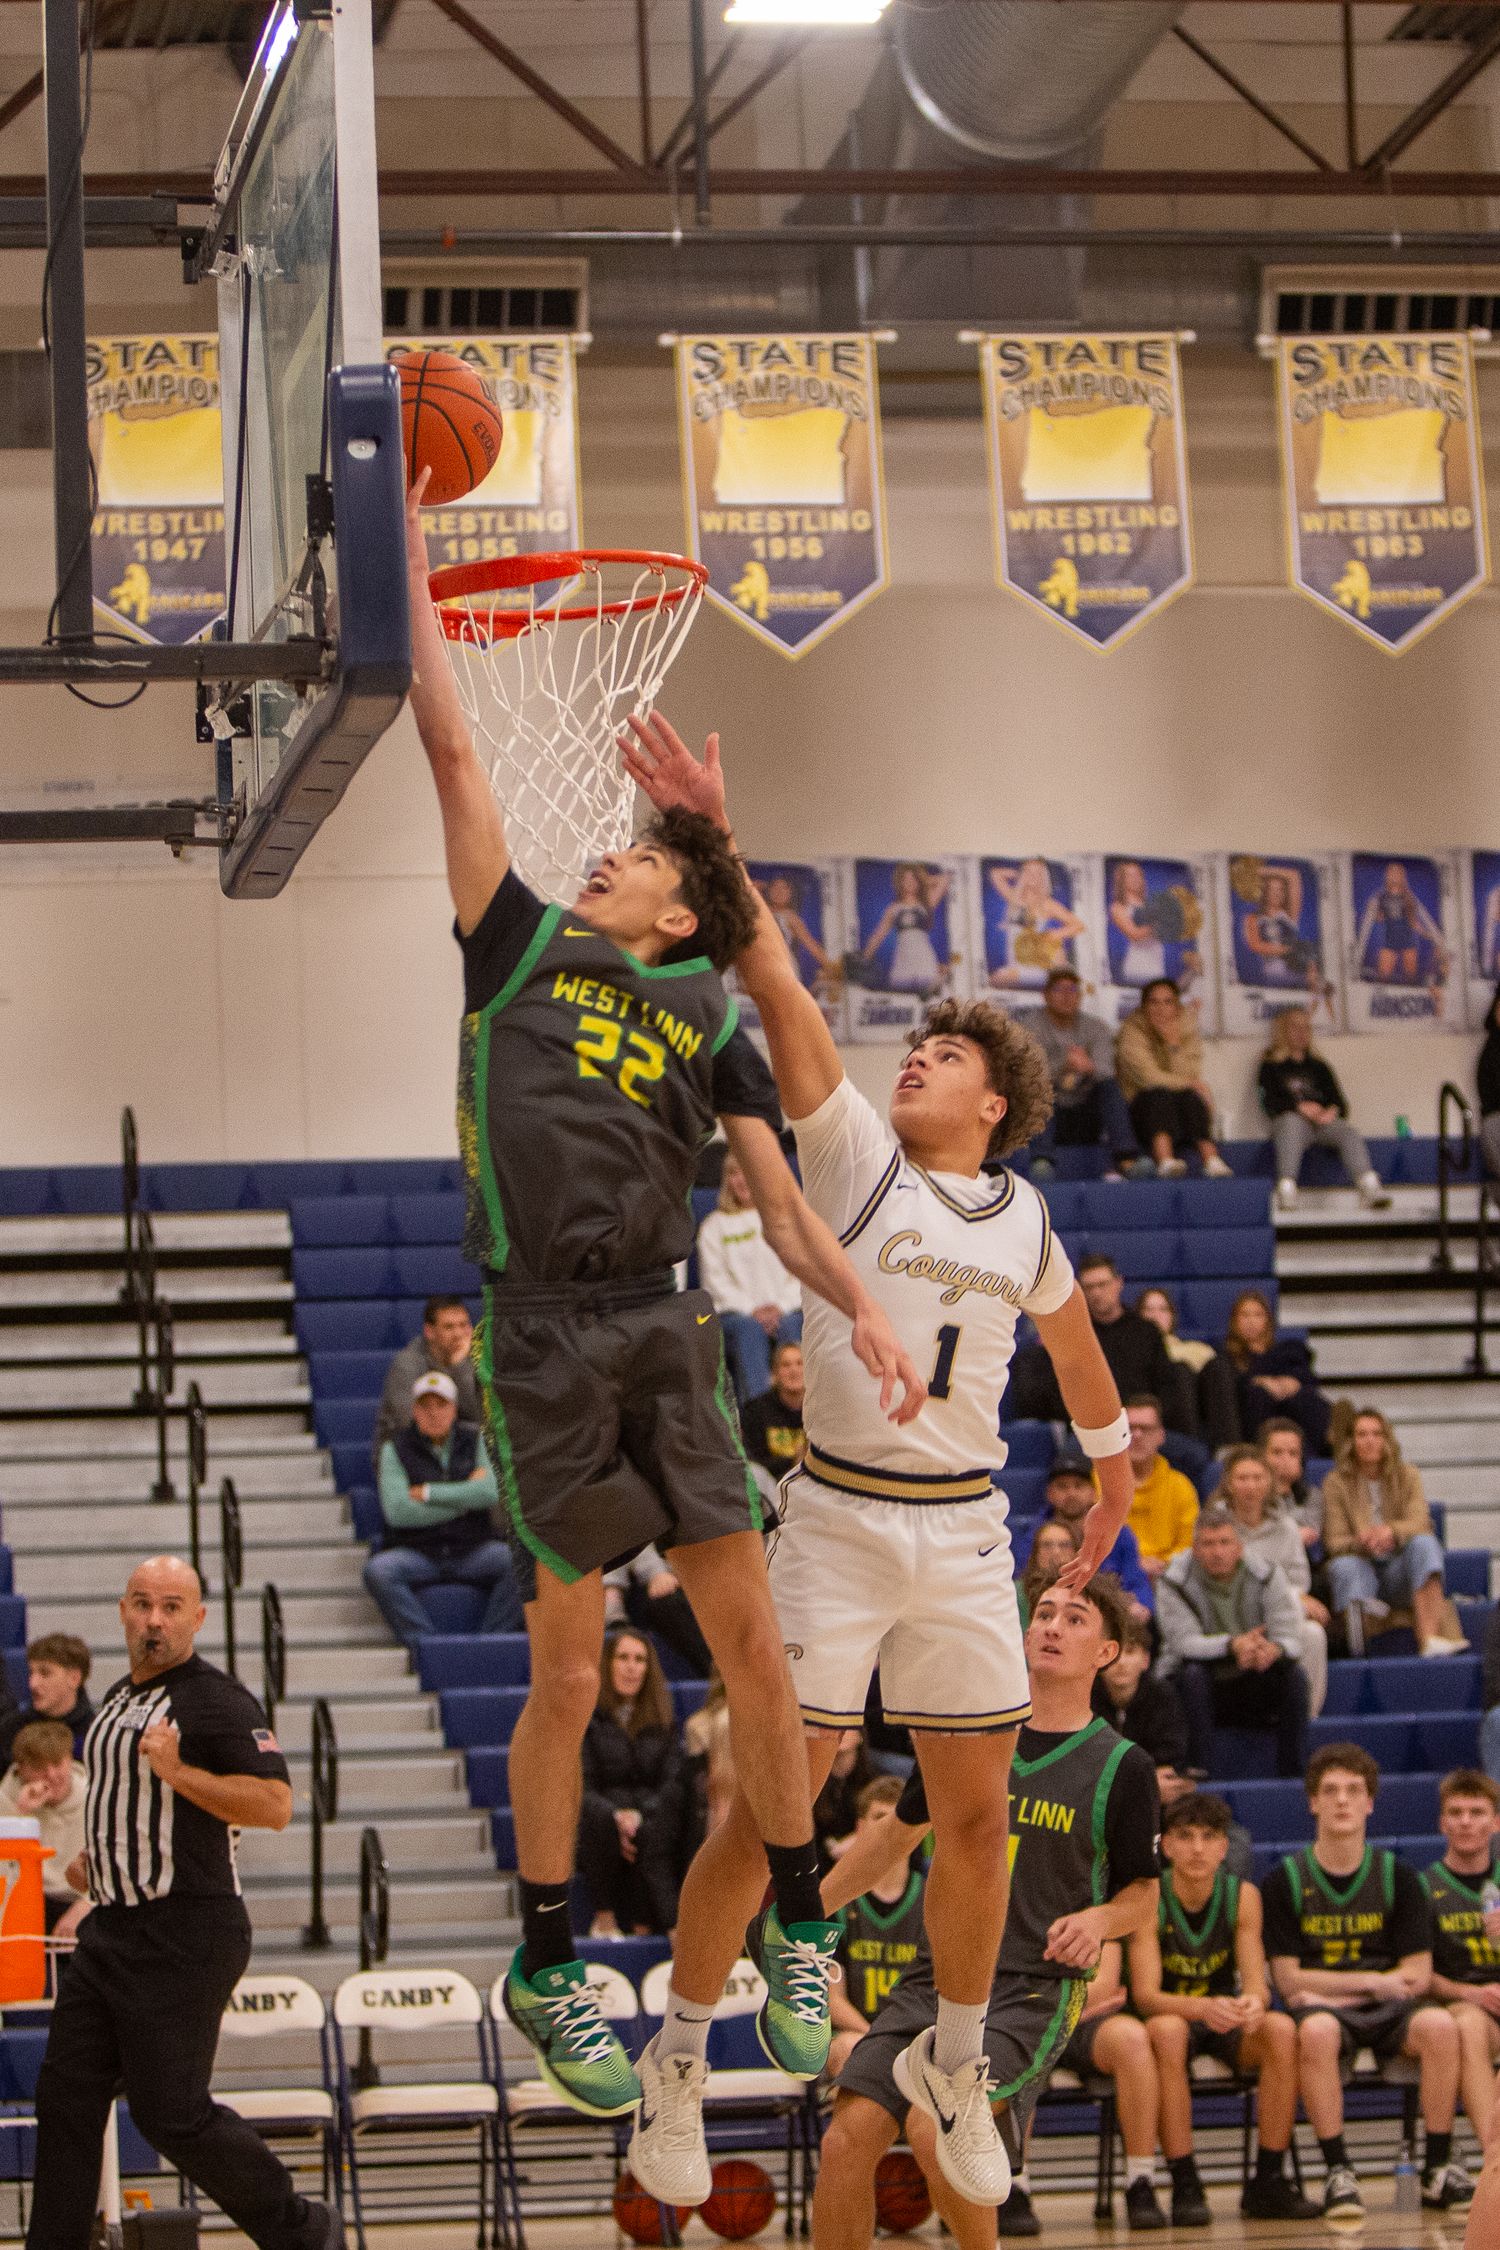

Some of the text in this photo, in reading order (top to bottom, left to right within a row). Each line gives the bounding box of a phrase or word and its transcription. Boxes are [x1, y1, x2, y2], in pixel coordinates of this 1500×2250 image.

[85, 340, 220, 387] STAT
[692, 340, 865, 385] STATE
[999, 339, 1172, 384] STATE
[1292, 341, 1464, 387] STATE
[694, 371, 868, 423] CHAMPIONS
[1000, 370, 1174, 422] CHAMPIONS
[420, 510, 569, 535] RESTLING
[701, 509, 872, 534] WRESTLING
[1007, 504, 1179, 531] WRESTLING
[1302, 506, 1472, 533] WRESTLING
[135, 538, 205, 561] 1947
[552, 972, 704, 1061] WEST LINN
[574, 1014, 667, 1109] 22
[927, 1321, 965, 1402] 1
[1017, 1796, 1076, 1834] LINN
[224, 1990, 298, 2013] ANBY
[361, 1985, 456, 2008] CANBY
